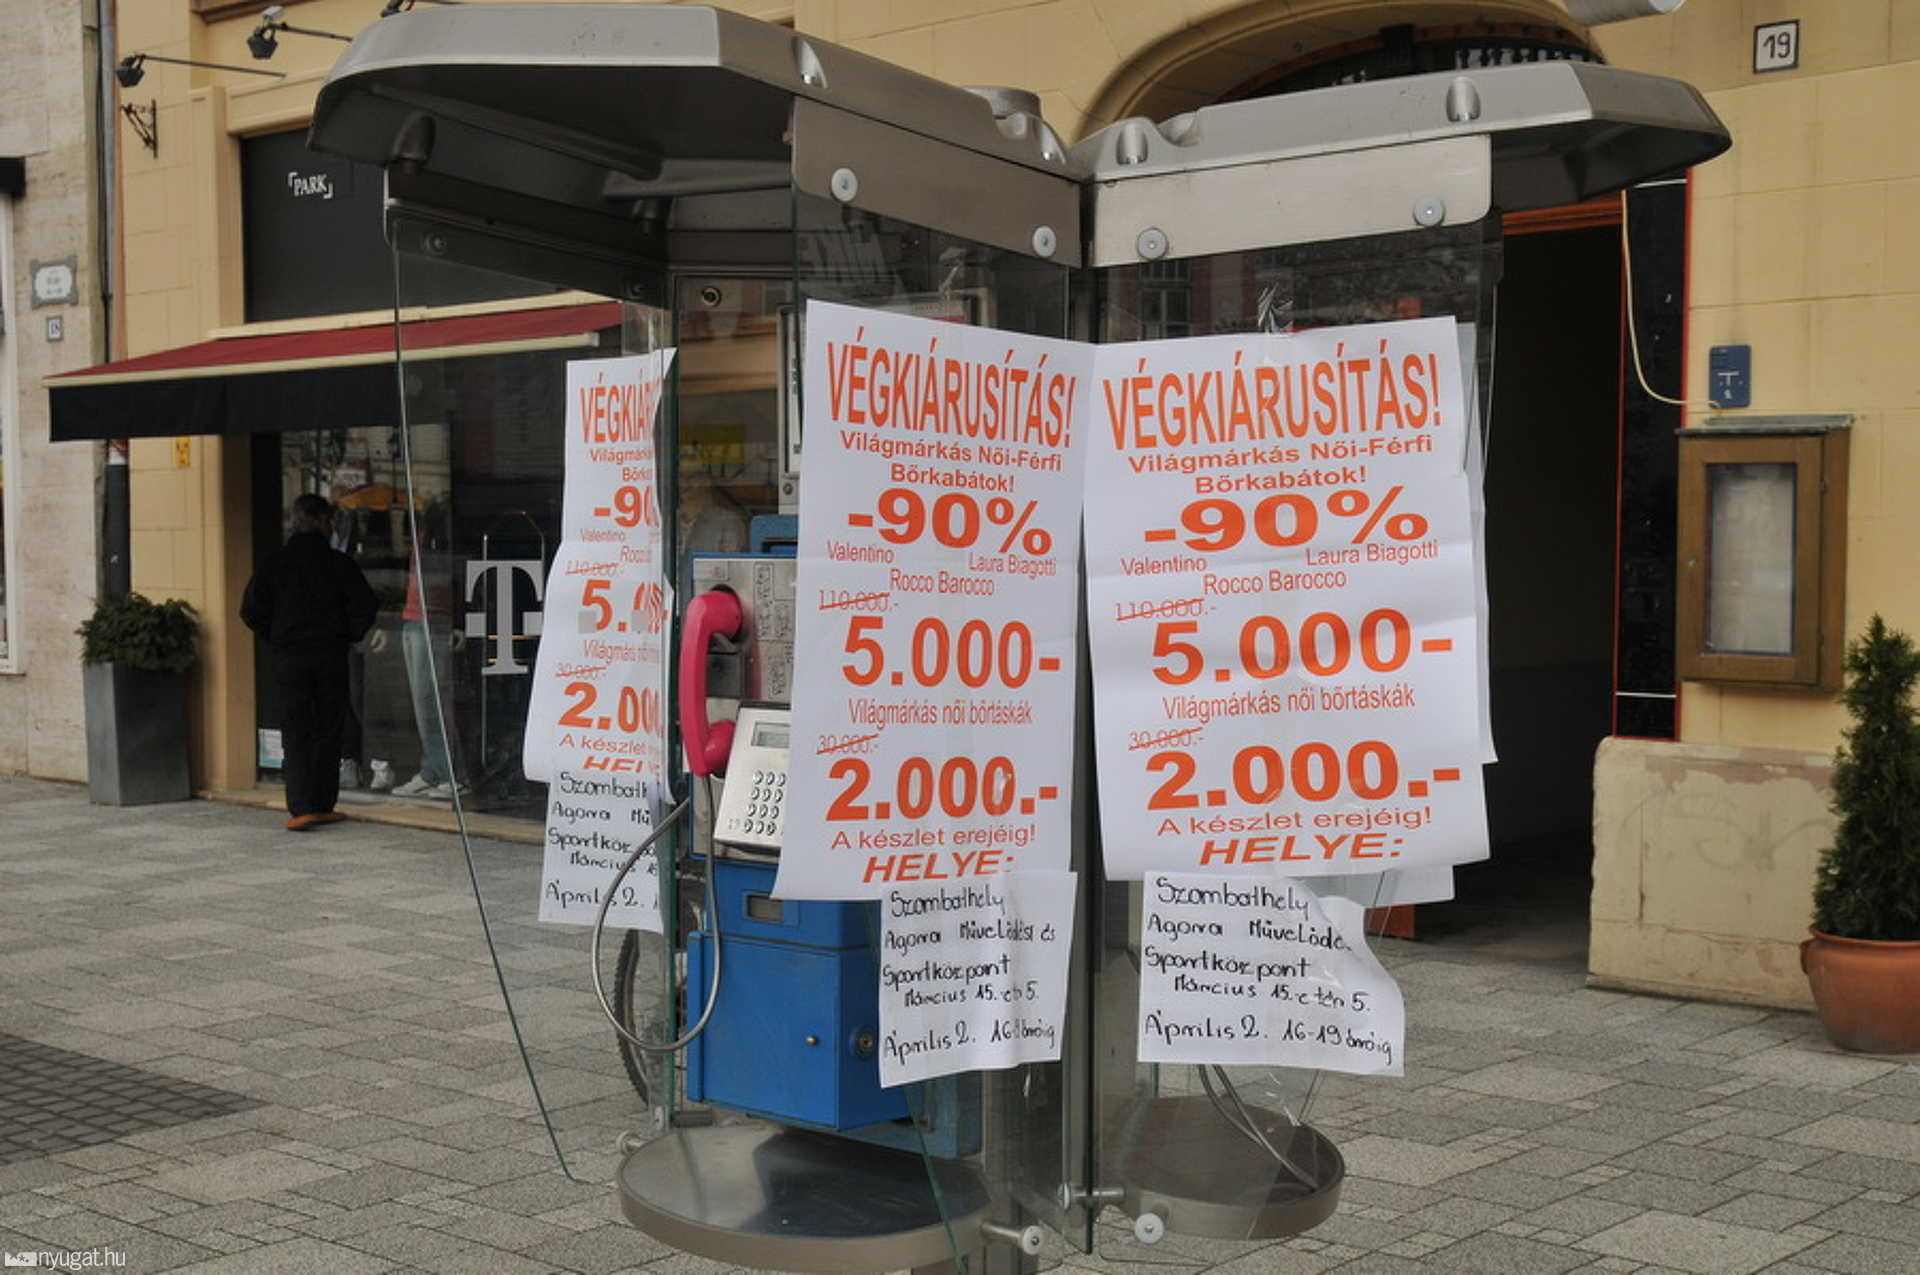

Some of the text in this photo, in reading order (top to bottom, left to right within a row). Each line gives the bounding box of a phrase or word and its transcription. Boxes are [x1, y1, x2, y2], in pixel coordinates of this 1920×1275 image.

[1763, 31, 1791, 59] 19
[827, 326, 1076, 449] VÉGKIÁRUSÍTÁS!
[1103, 338, 1442, 450] VÉGKIÁRUSÍTÁS!
[839, 430, 972, 459] Világmárkás
[1128, 446, 1300, 475] Világmárkás
[890, 462, 1015, 492] Bőrkabátok!
[1195, 465, 1367, 494] Bőrkabátok!
[580, 528, 625, 542] Valentino
[848, 487, 1052, 556] -90%
[1144, 486, 1429, 552] -90%
[827, 540, 1057, 579] Valentino Laura Biagotti
[1121, 539, 1439, 577] Valentino Laura Biagotti
[890, 569, 995, 596] Rocco Barocco
[1203, 569, 1347, 596] Rocco Barocco
[464, 559, 544, 675] T
[842, 616, 1060, 688] 5.000-
[1152, 608, 1453, 685] 5.000-
[848, 698, 938, 730] Világmárkás
[1162, 690, 1281, 725] Világmárkás
[559, 733, 576, 748] A
[826, 756, 1058, 821] 2.000.-
[1145, 740, 1460, 811] 2.000.-
[552, 801, 611, 825] Agora
[1157, 807, 1432, 836] A készlet erejéig!
[831, 825, 1036, 850] A készlet erejéig!
[1200, 833, 1404, 866] HELYE:
[891, 884, 1006, 917] Szombathely
[1157, 877, 1309, 920] Szombathely
[885, 930, 942, 956] Agora
[1146, 914, 1223, 941] Agora
[884, 1030, 952, 1065] Április
[955, 1020, 976, 1044] 2.
[1145, 1010, 1234, 1045] Április
[1241, 1014, 1268, 1039] 2.
[1282, 1019, 1342, 1046] 16-19
